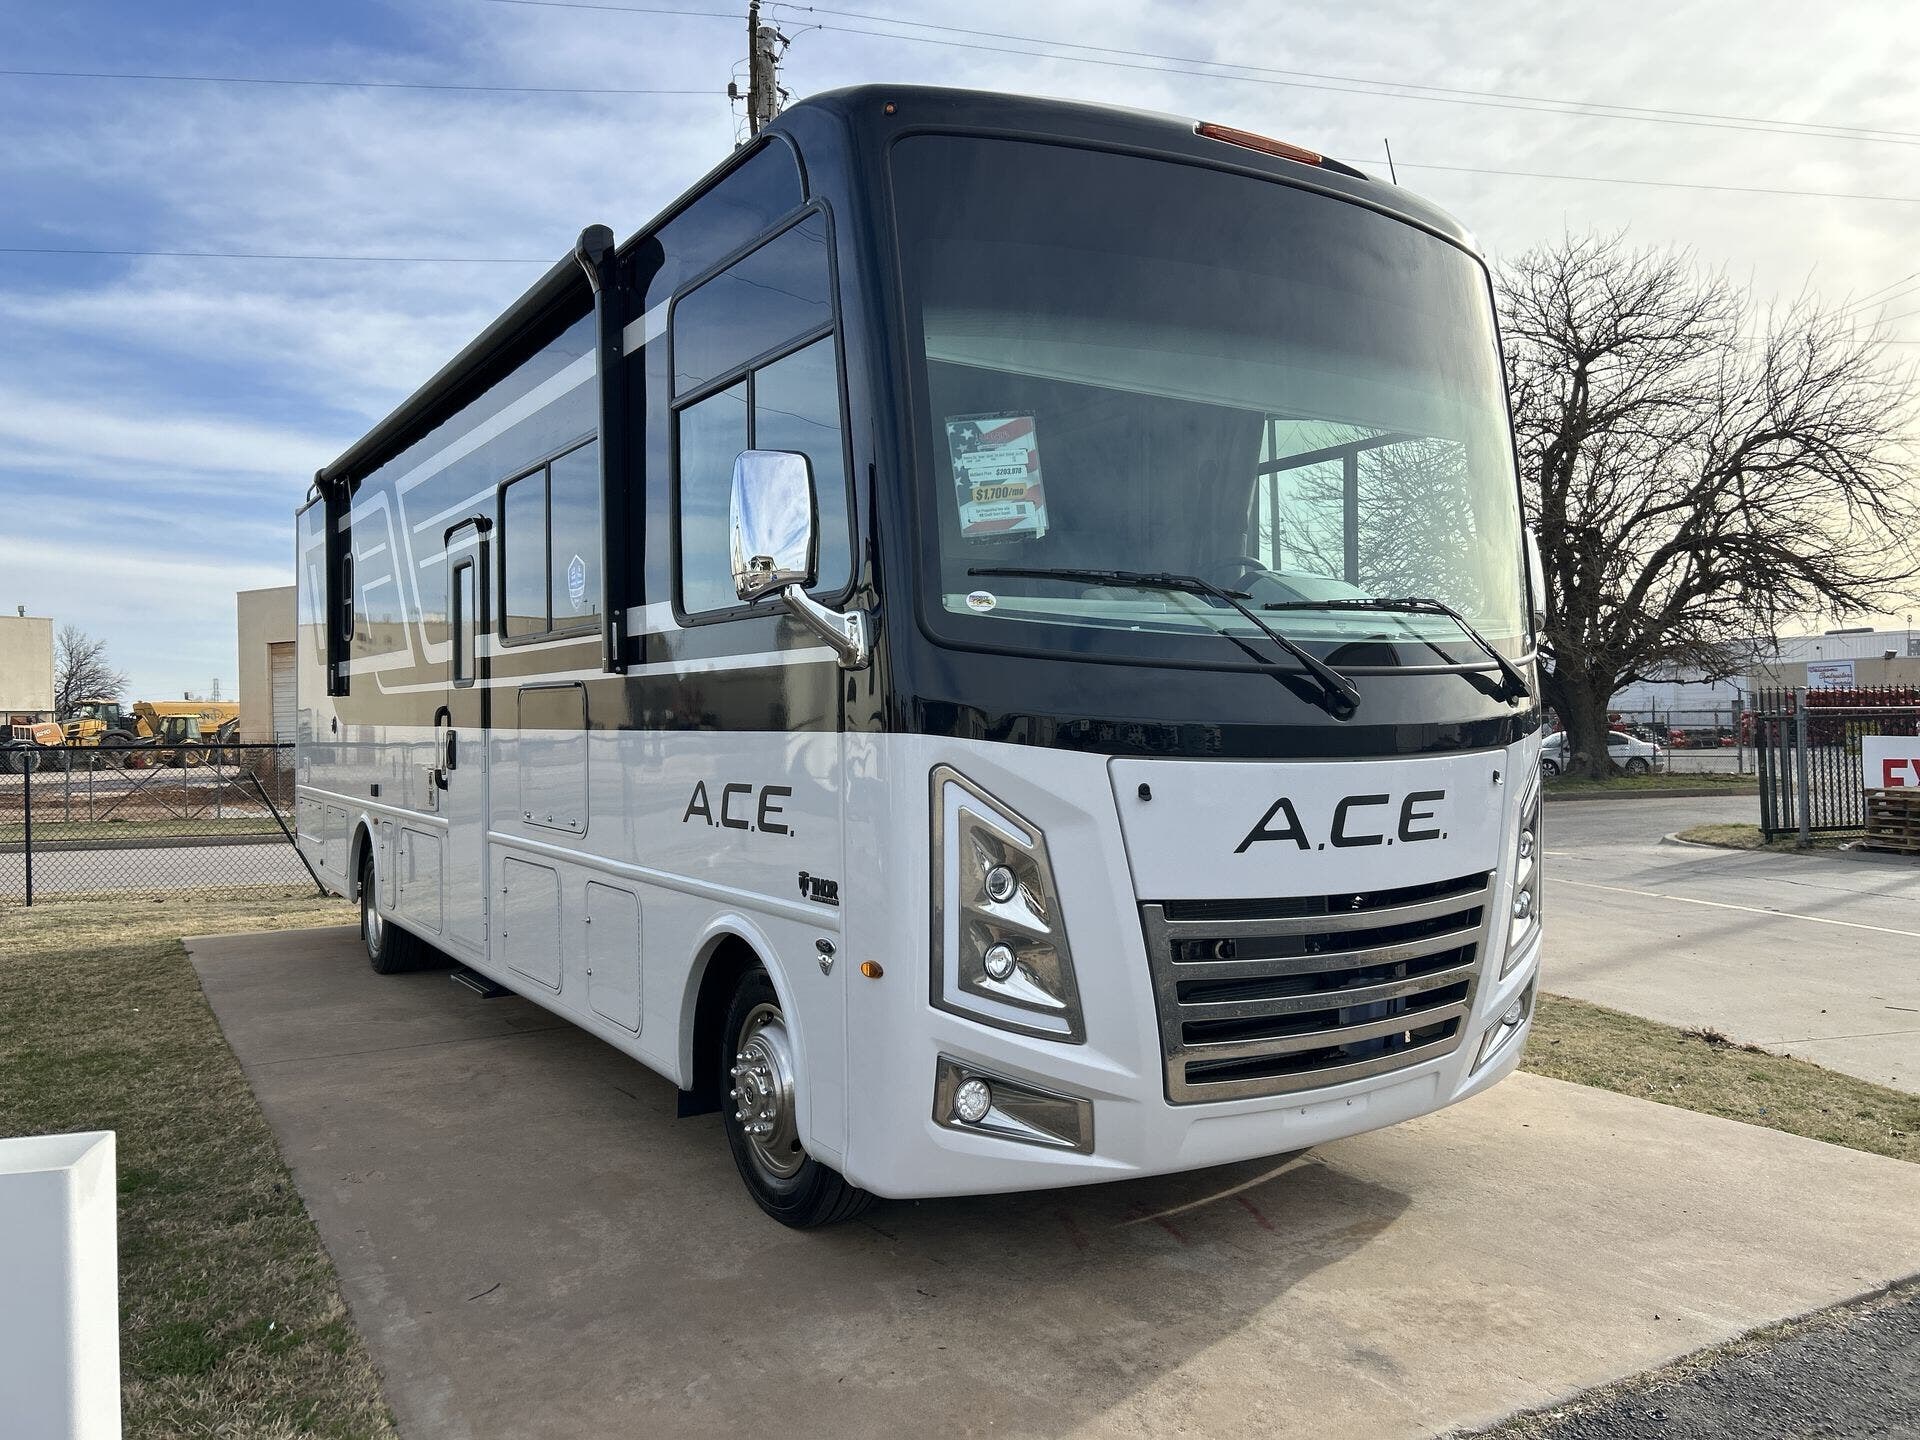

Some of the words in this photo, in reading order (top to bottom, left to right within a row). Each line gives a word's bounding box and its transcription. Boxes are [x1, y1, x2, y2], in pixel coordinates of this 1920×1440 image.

[976, 486, 1024, 501] $1,700/mo
[682, 780, 795, 838] A.C.E.
[1233, 789, 1448, 854] A.C.E.
[809, 877, 839, 899] THOR
